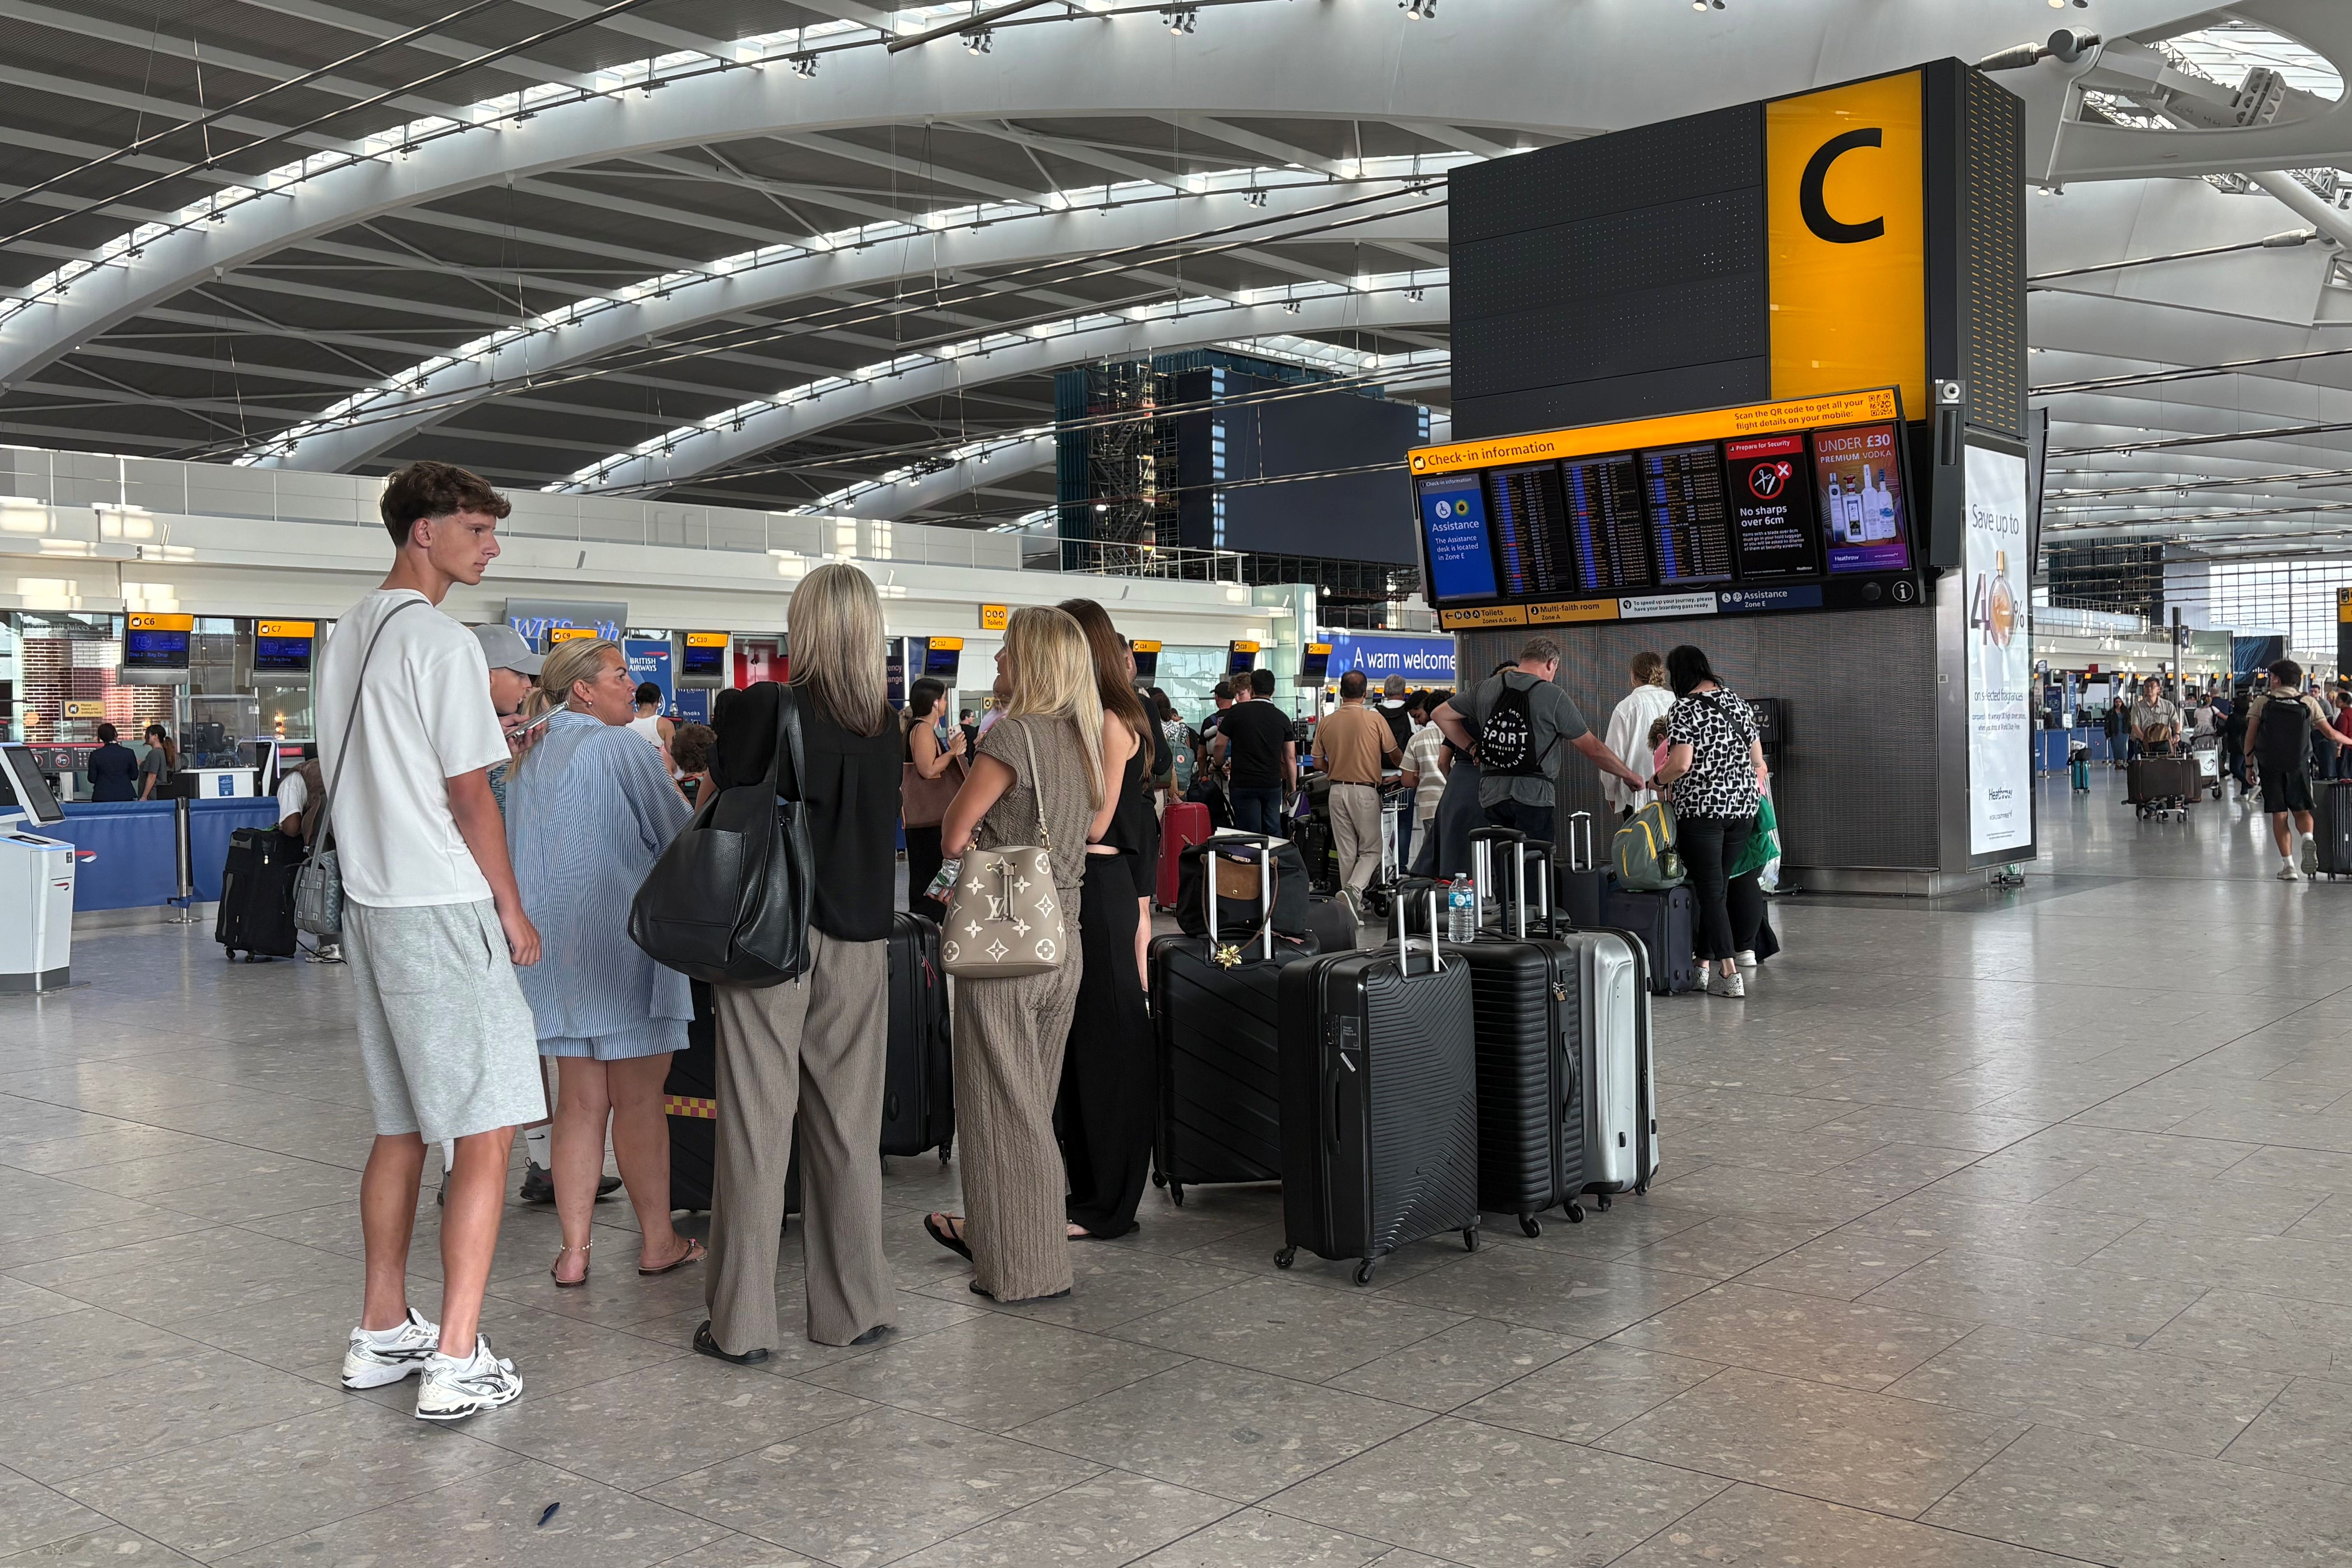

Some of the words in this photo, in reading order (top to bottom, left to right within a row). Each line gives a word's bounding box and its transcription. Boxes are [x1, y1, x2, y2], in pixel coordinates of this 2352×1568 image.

[1799, 127, 1885, 244] C
[1770, 408, 1782, 416] QR
[1784, 406, 1804, 414] code
[1818, 403, 1830, 412] get
[1845, 399, 1864, 409] your
[1736, 420, 1758, 430] flight
[1760, 418, 1786, 427] details
[1801, 415, 1820, 424] your
[1822, 411, 1853, 420] mobile:
[1819, 437, 1862, 453] UNDER
[1867, 434, 1890, 448] £30
[1428, 450, 1479, 465] Check-in
[1482, 441, 1554, 459] information
[1820, 453, 1860, 463] PREMIUM
[1862, 450, 1892, 459] VODKA
[1445, 477, 1472, 485] information
[1740, 508, 1753, 516] No
[1755, 506, 1787, 515] sharps
[1432, 520, 1479, 532] Assistance
[1765, 516, 1784, 525] 6cm
[1972, 504, 1994, 531] Save
[1996, 515, 2008, 539] up
[2009, 513, 2019, 534] to
[1447, 535, 1477, 544] Assistance
[1744, 590, 1787, 600] Assistance
[1540, 604, 1578, 613] Multi-faith
[510, 617, 620, 641] WHith
[1353, 646, 1364, 668] A
[1367, 652, 1400, 669] warm
[1403, 648, 1456, 670] welcome
[1483, 727, 1528, 744] SPORT
